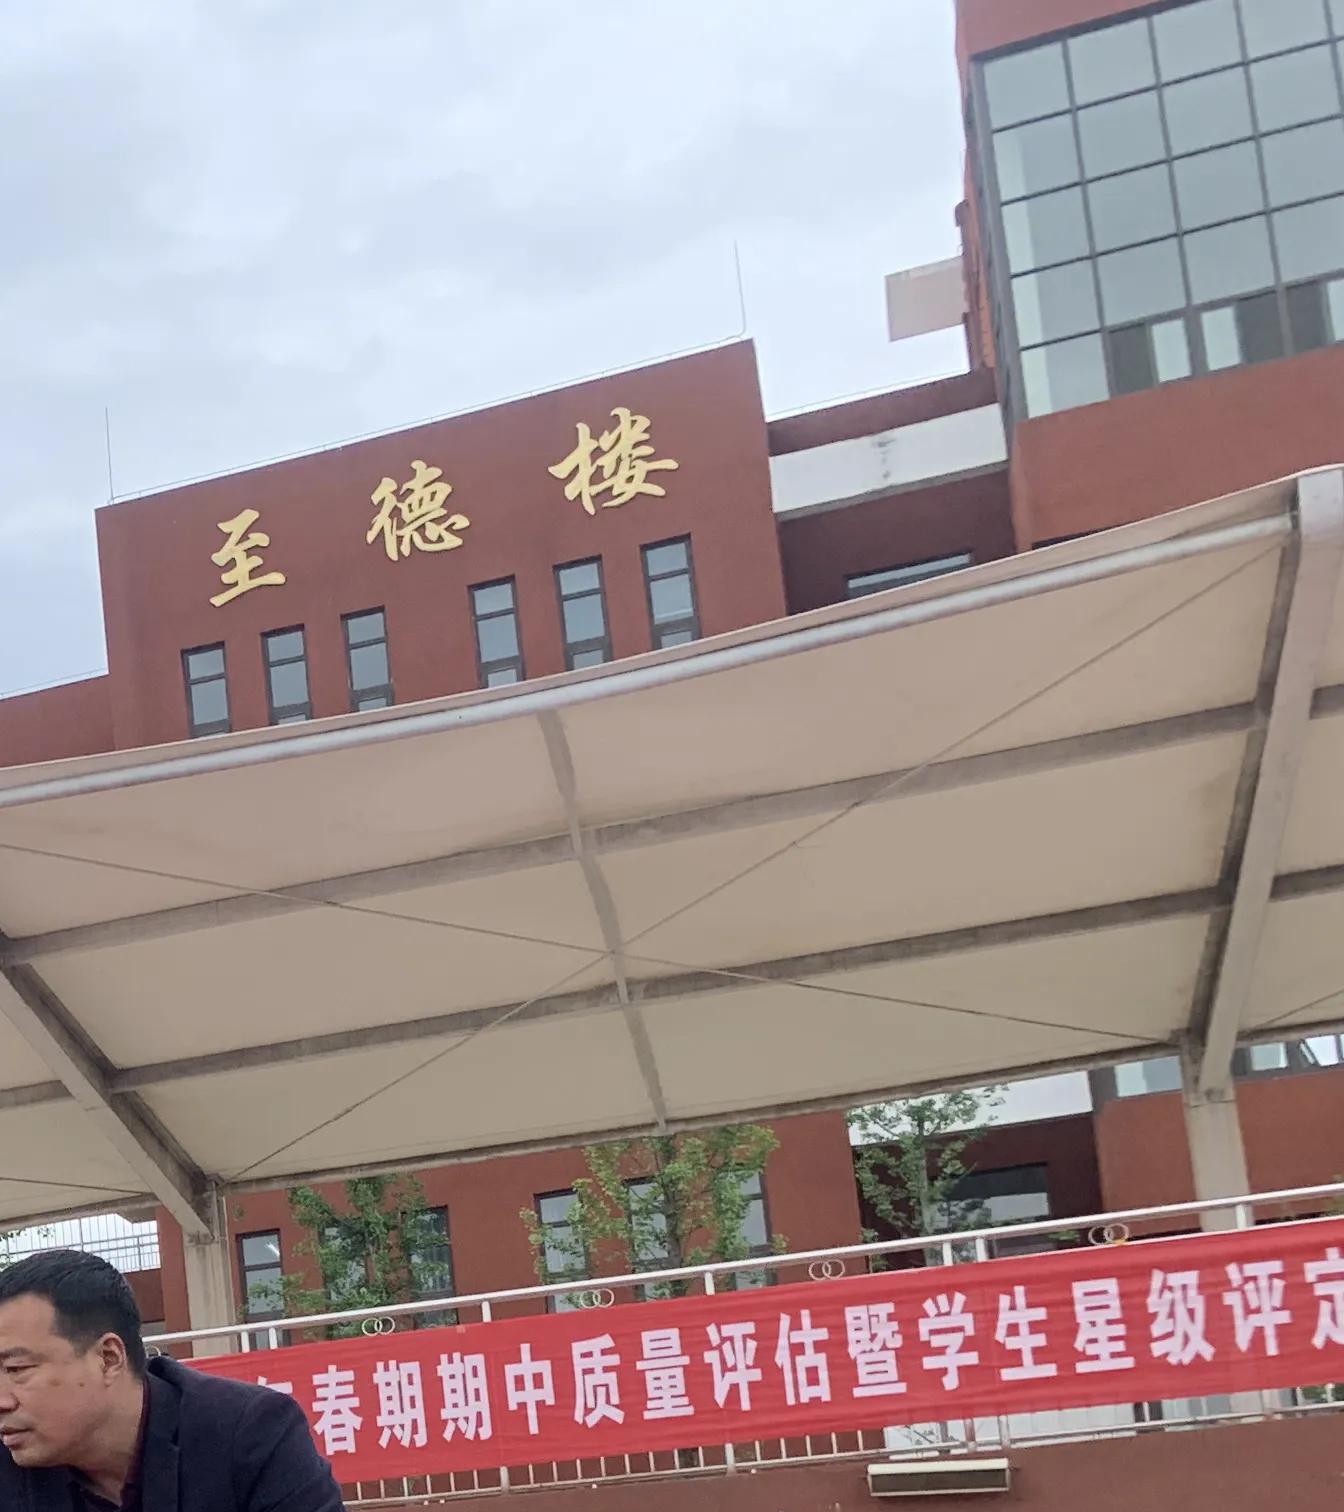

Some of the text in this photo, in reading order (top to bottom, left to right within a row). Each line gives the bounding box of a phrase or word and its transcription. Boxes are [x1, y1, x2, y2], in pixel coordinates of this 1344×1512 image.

[209, 406, 680, 607] 至德楼
[254, 1246, 1344, 1456] 春期期中质量评估暨学生星级评定
